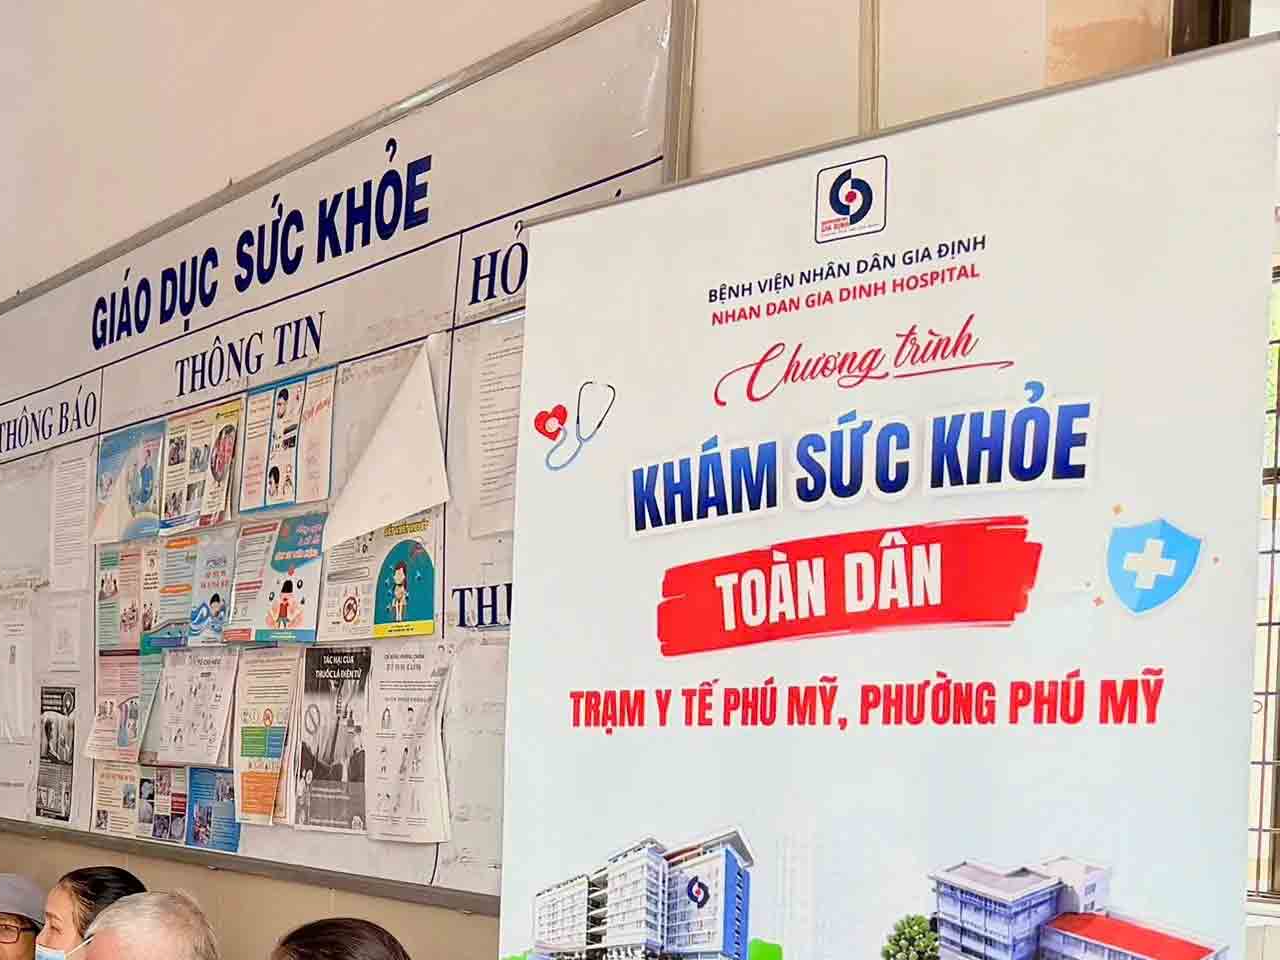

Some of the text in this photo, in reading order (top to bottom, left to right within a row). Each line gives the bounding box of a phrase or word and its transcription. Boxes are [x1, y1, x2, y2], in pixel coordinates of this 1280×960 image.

[91, 137, 432, 350] GIÁO DỤC SỨC KHỎE
[708, 235, 987, 304] BỆNH VIỆN NHÂN DÂN GIA ĐỊNH
[711, 263, 980, 327] NHAN DAN GIA DINH HOSPITAL
[175, 311, 326, 397] THÔNG TIN
[714, 313, 990, 406] Chương trình
[58, 385, 97, 435] BÁO
[632, 381, 1090, 531] KHÁM SỨC KHỎE
[715, 530, 942, 632] TOÀN DÂN
[570, 668, 1164, 735] TRẠM Y TẾ PHÚ MỸ, PHƯỜNG PHÚ MỸ
